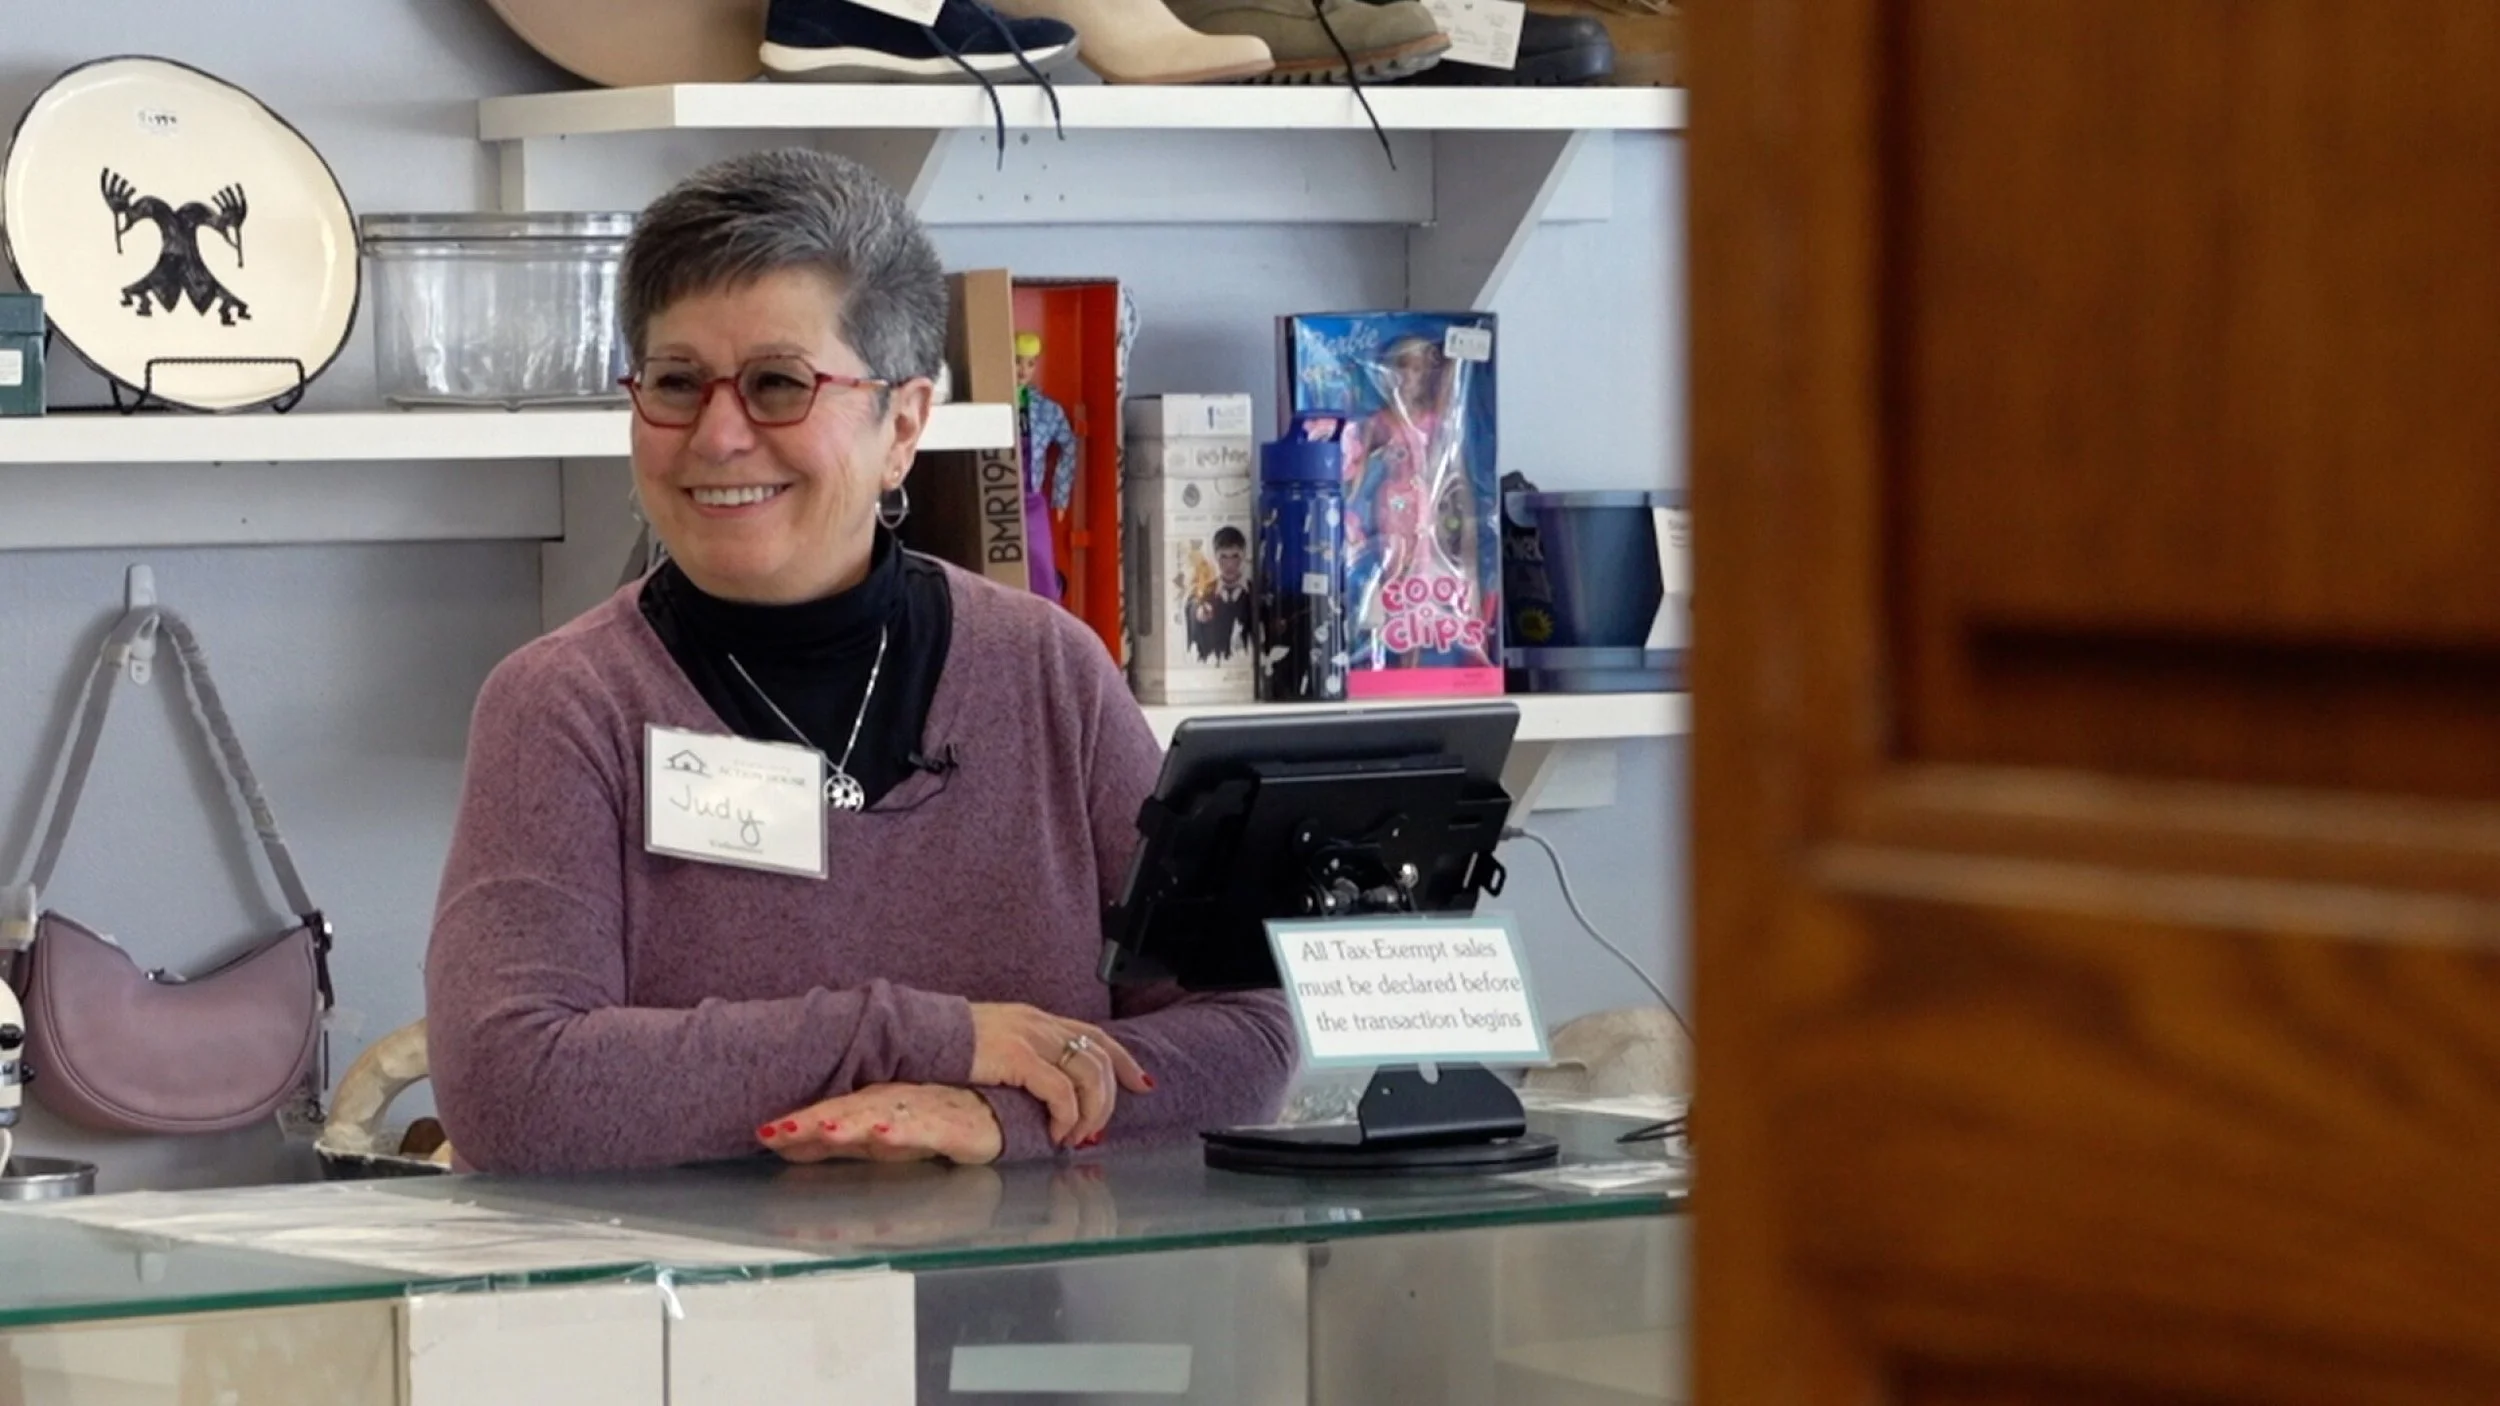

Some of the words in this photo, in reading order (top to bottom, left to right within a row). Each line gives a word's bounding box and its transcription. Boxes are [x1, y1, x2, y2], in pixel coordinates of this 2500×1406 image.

[669, 784, 765, 848] Judy
[1301, 941, 1329, 962] All
[1332, 939, 1448, 963] Tax-Exempt
[1452, 937, 1498, 958] sales
[1299, 979, 1343, 997] must
[1347, 975, 1373, 995] be
[1378, 973, 1457, 994] declared
[1459, 970, 1522, 992] before
[1316, 1010, 1348, 1032] the
[1353, 1010, 1458, 1031] transaction
[1460, 1008, 1523, 1032] begins
